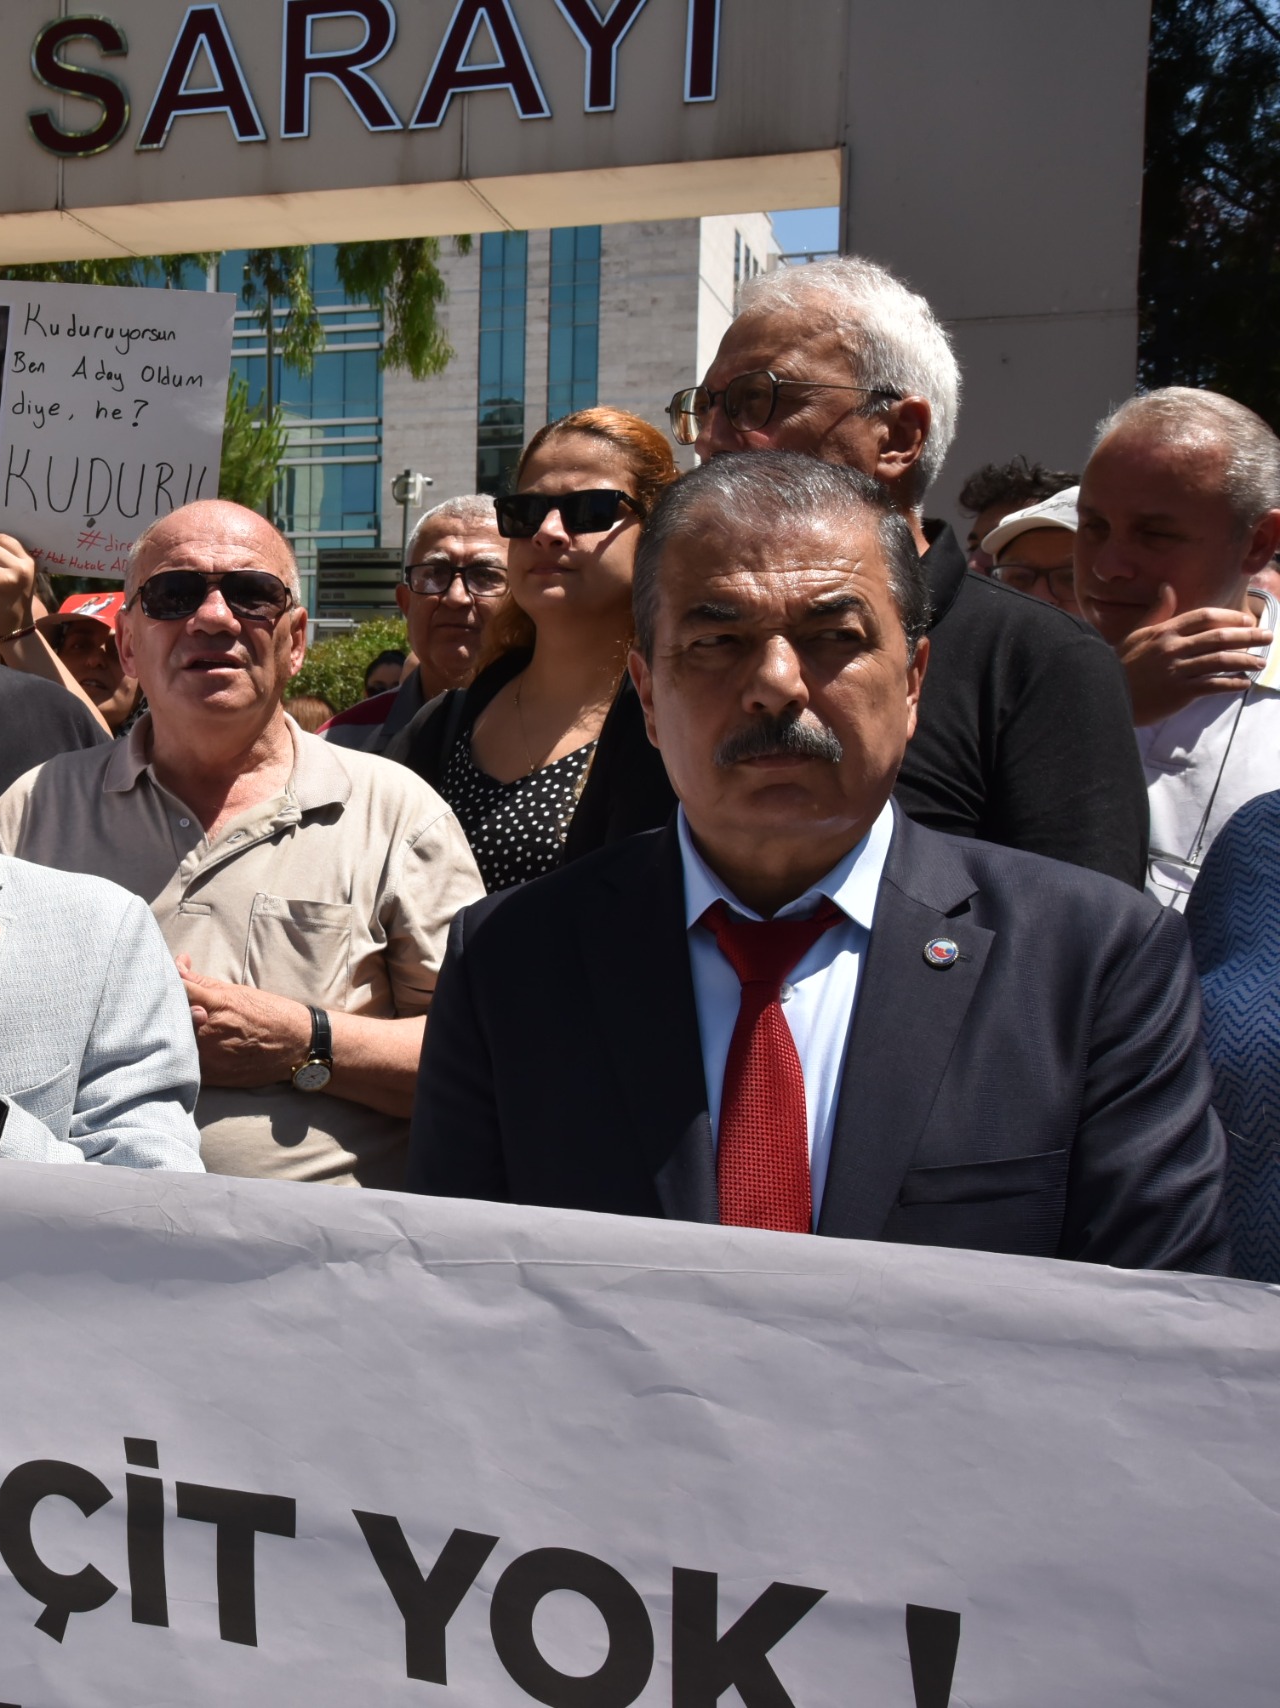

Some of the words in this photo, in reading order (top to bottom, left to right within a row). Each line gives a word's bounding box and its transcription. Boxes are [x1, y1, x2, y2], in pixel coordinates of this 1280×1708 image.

[26, 0, 722, 159] SARAYI
[11, 351, 45, 373] Ben
[72, 356, 124, 392] Aday
[141, 365, 203, 388] Oldum
[24, 302, 176, 355] Kuduruyorsun
[351, 1508, 829, 1708] YOK
